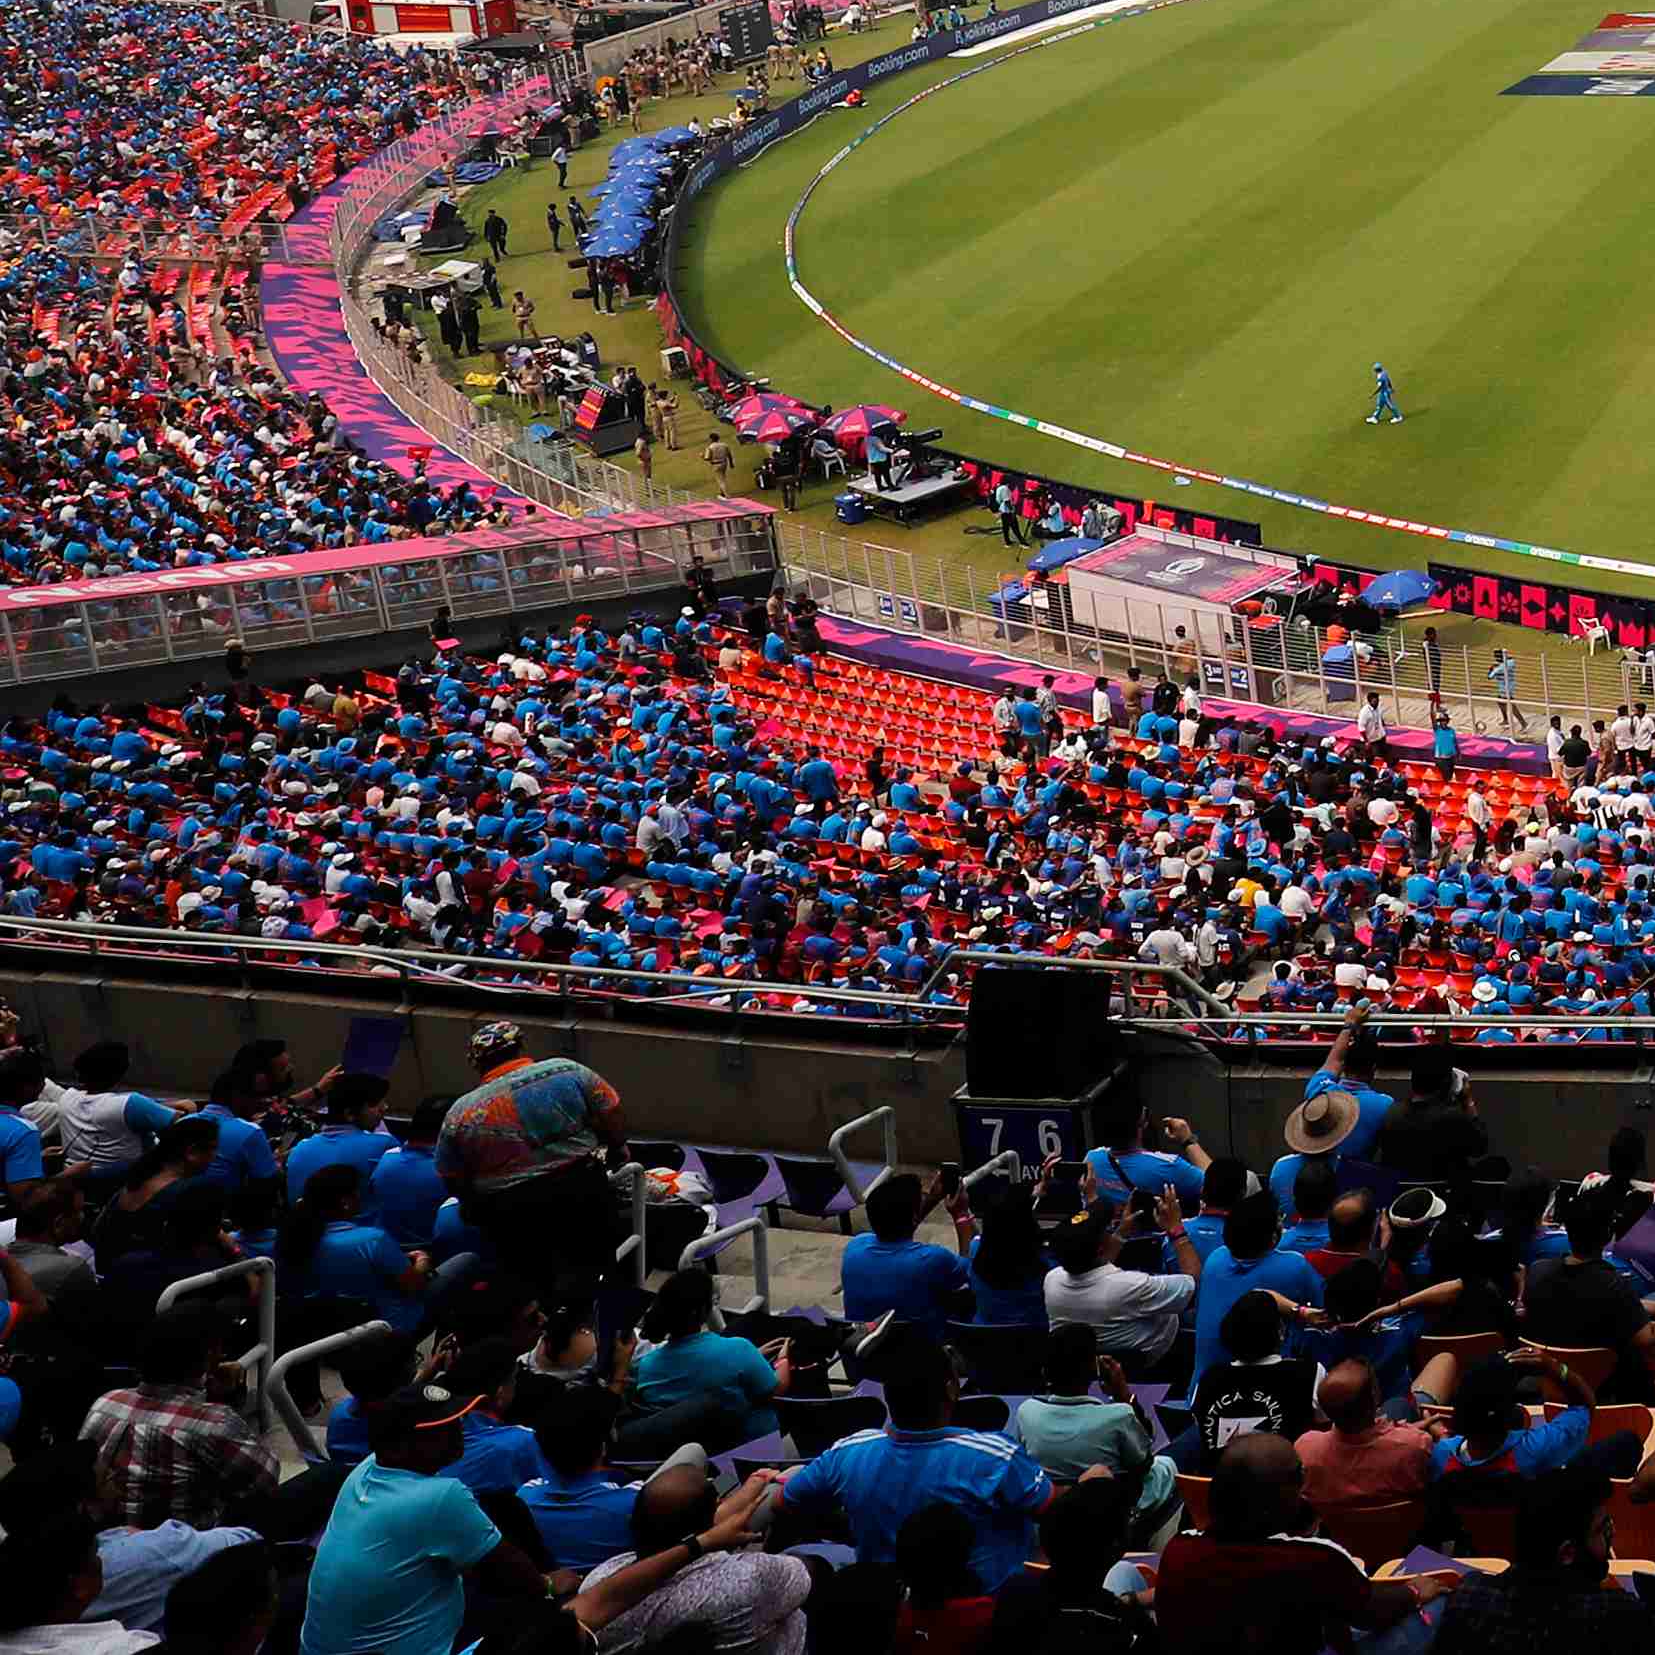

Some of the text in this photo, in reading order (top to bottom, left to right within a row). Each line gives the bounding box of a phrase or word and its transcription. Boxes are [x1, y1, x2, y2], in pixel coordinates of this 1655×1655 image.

[868, 43, 929, 78] Booking.com
[797, 78, 848, 115] Booking.com
[731, 116, 781, 157] Booking.com
[1465, 533, 1496, 547] aramco
[1529, 547, 1561, 560] aramco
[982, 1118, 1003, 1156] 7
[1037, 1119, 1062, 1158] 6
[1204, 1391, 1244, 1450] NAUTICA
